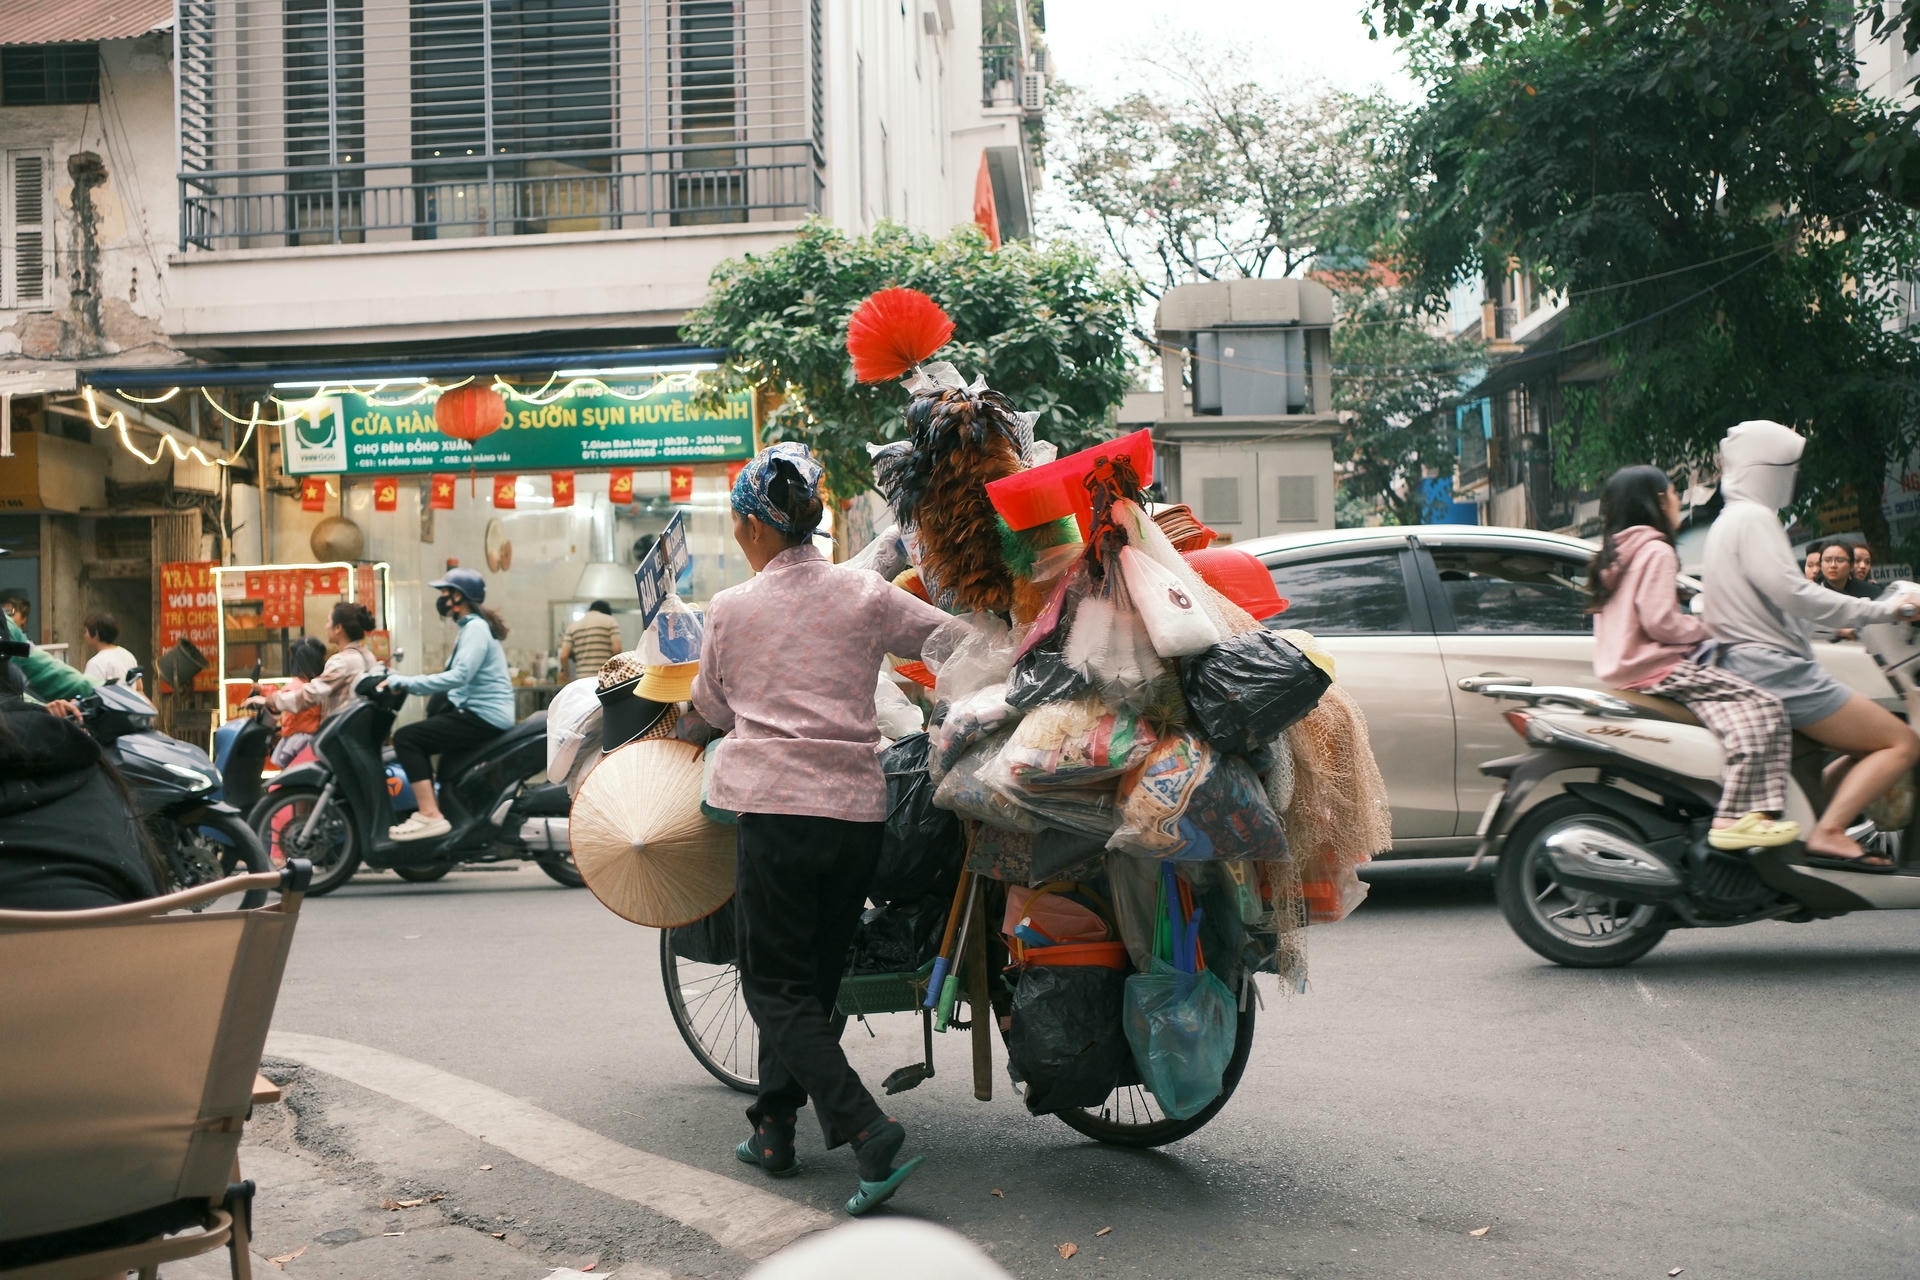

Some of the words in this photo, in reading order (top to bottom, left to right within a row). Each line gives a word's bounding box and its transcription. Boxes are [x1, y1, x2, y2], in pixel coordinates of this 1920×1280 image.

[351, 410, 393, 436] CỬA
[396, 410, 439, 434] HÀN
[518, 404, 577, 429] SƯỜN
[582, 405, 625, 430] SỤN
[630, 399, 700, 424] HUYỀN
[354, 442, 379, 456] CHỢ
